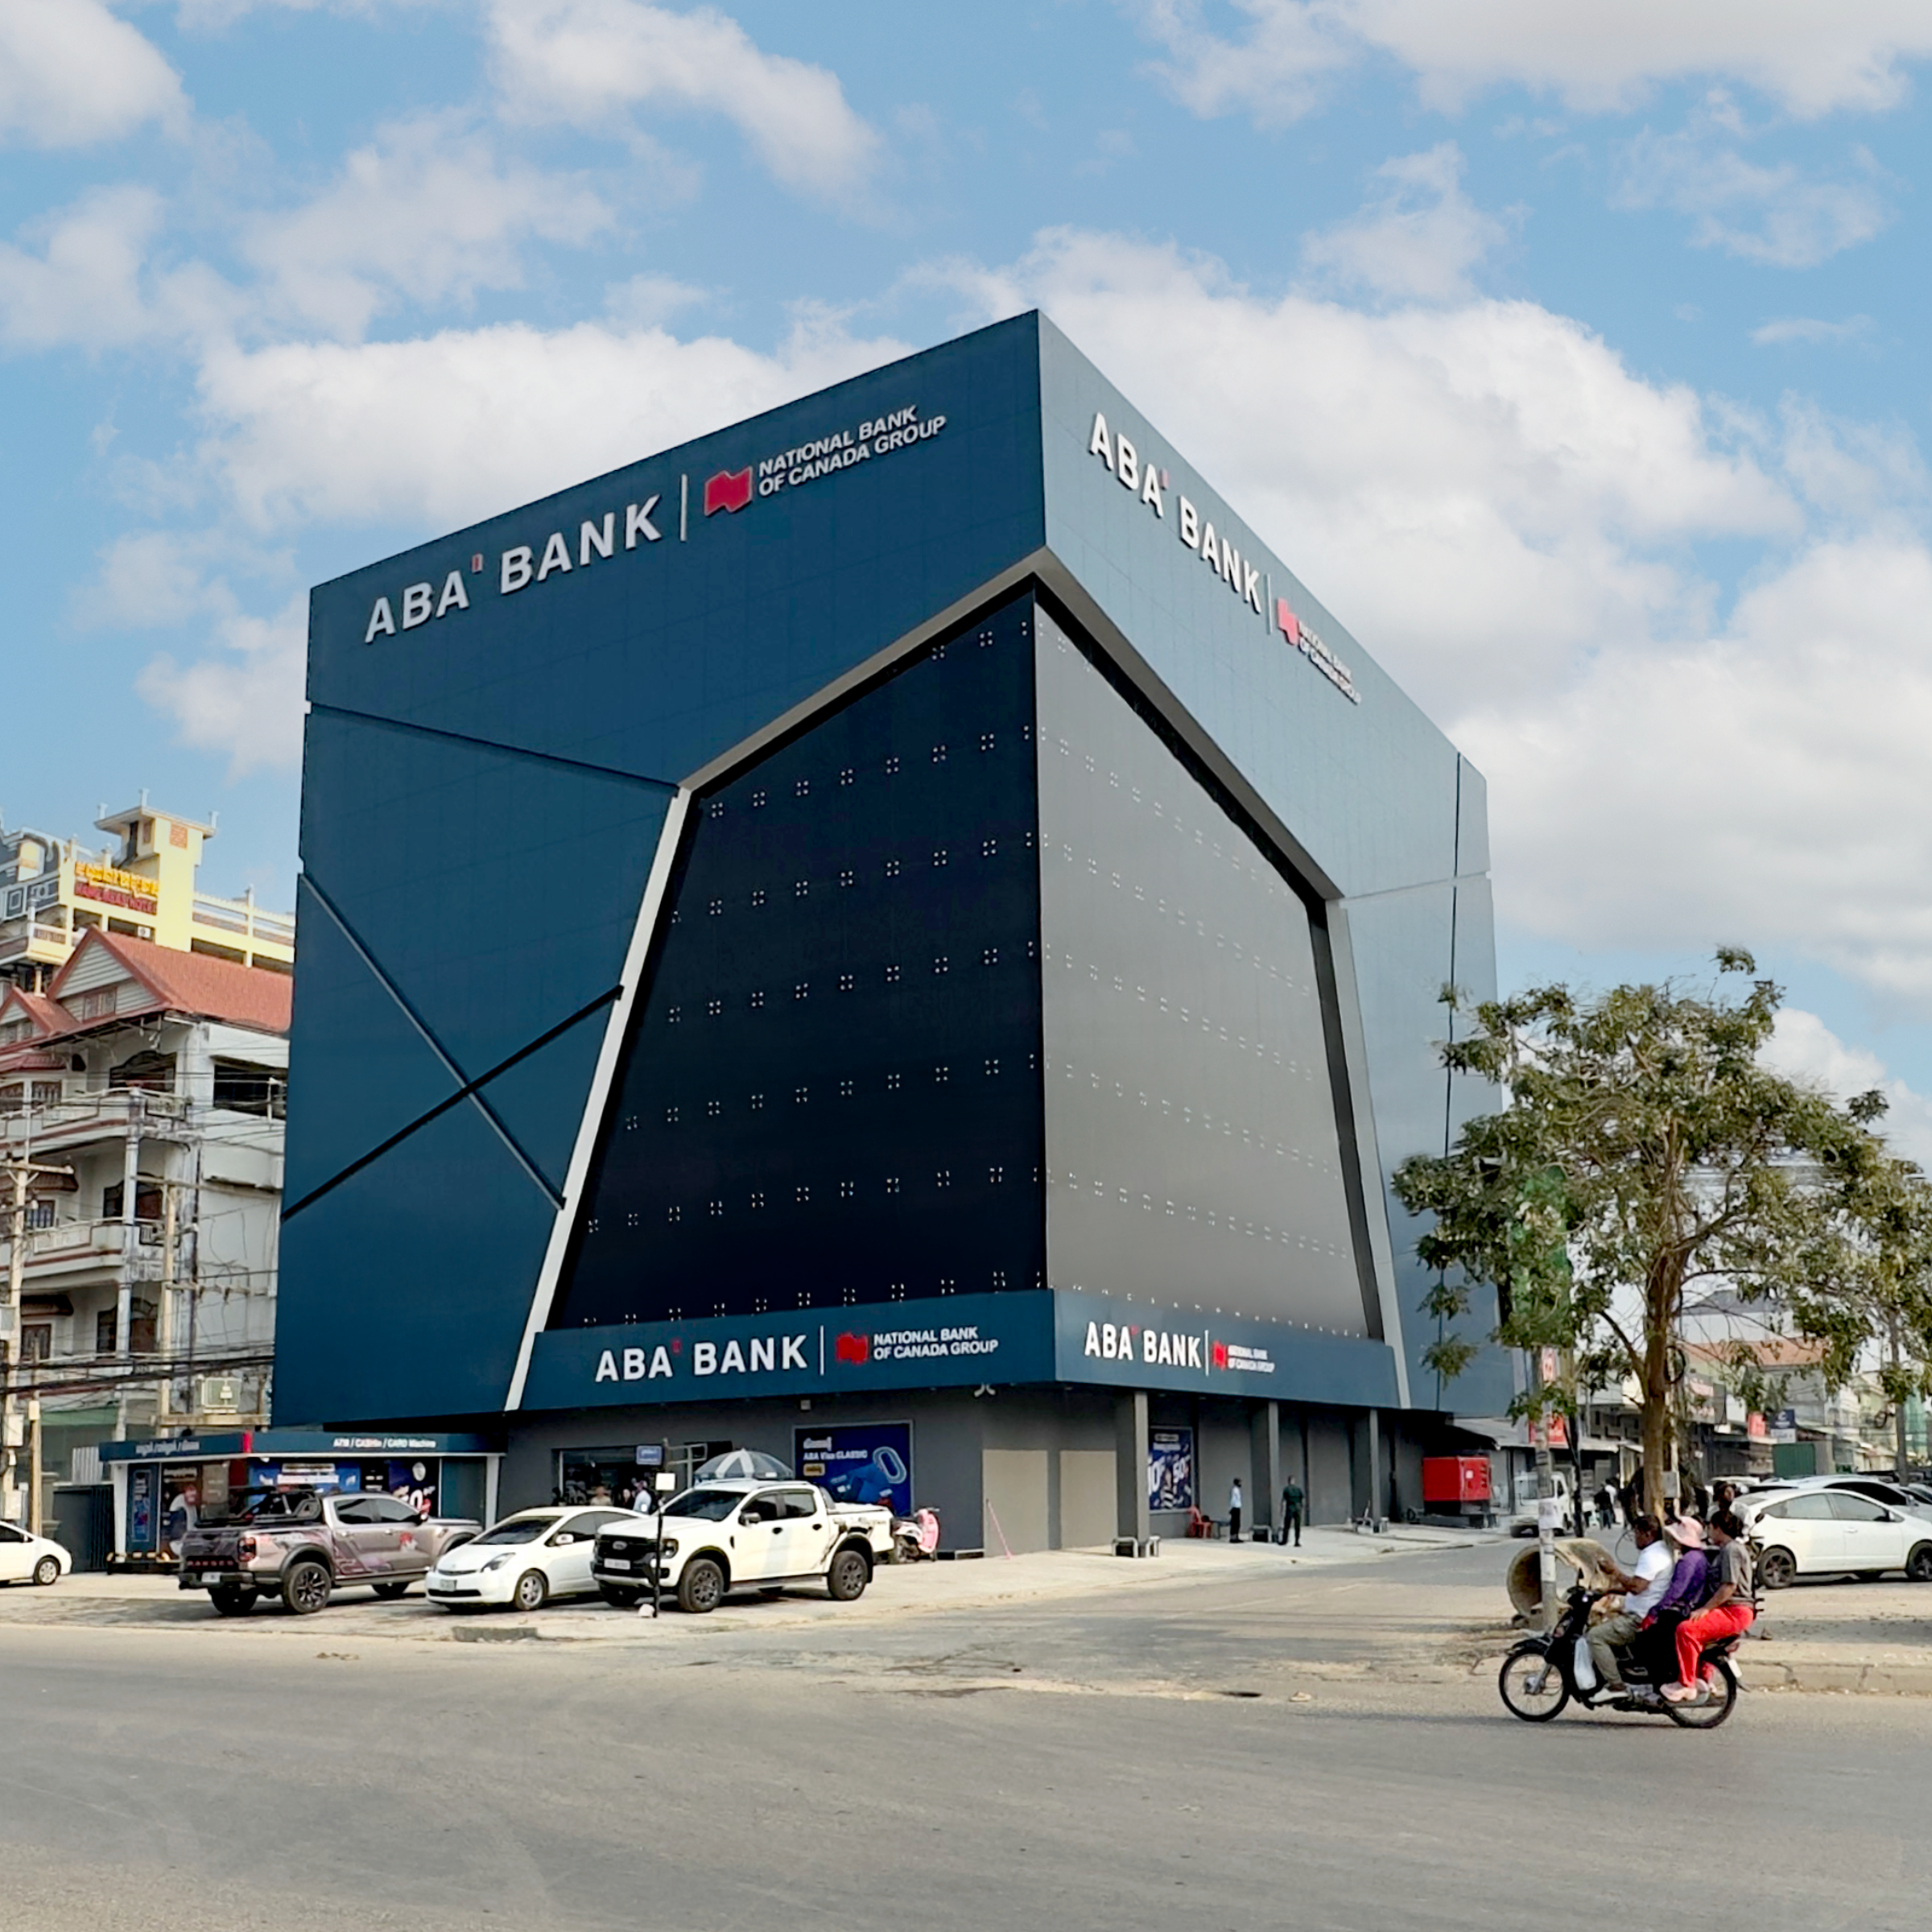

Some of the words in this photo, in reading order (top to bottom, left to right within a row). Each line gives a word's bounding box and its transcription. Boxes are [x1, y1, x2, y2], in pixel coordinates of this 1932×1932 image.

[758, 430, 854, 477] NATIONAL
[858, 405, 917, 440] BANK
[758, 473, 786, 497] OF
[788, 444, 870, 485] CANADA
[874, 415, 946, 454] GROUP
[500, 493, 662, 595] BANK
[1179, 495, 1261, 613] BANK
[694, 1335, 807, 1375] BANK
[873, 1329, 938, 1346] NATIONAL
[940, 1327, 978, 1341] BANK
[873, 1347, 892, 1360] OF
[894, 1343, 948, 1359] CANADA
[950, 1340, 999, 1356] GROUP
[1143, 1330, 1202, 1368] BANK
